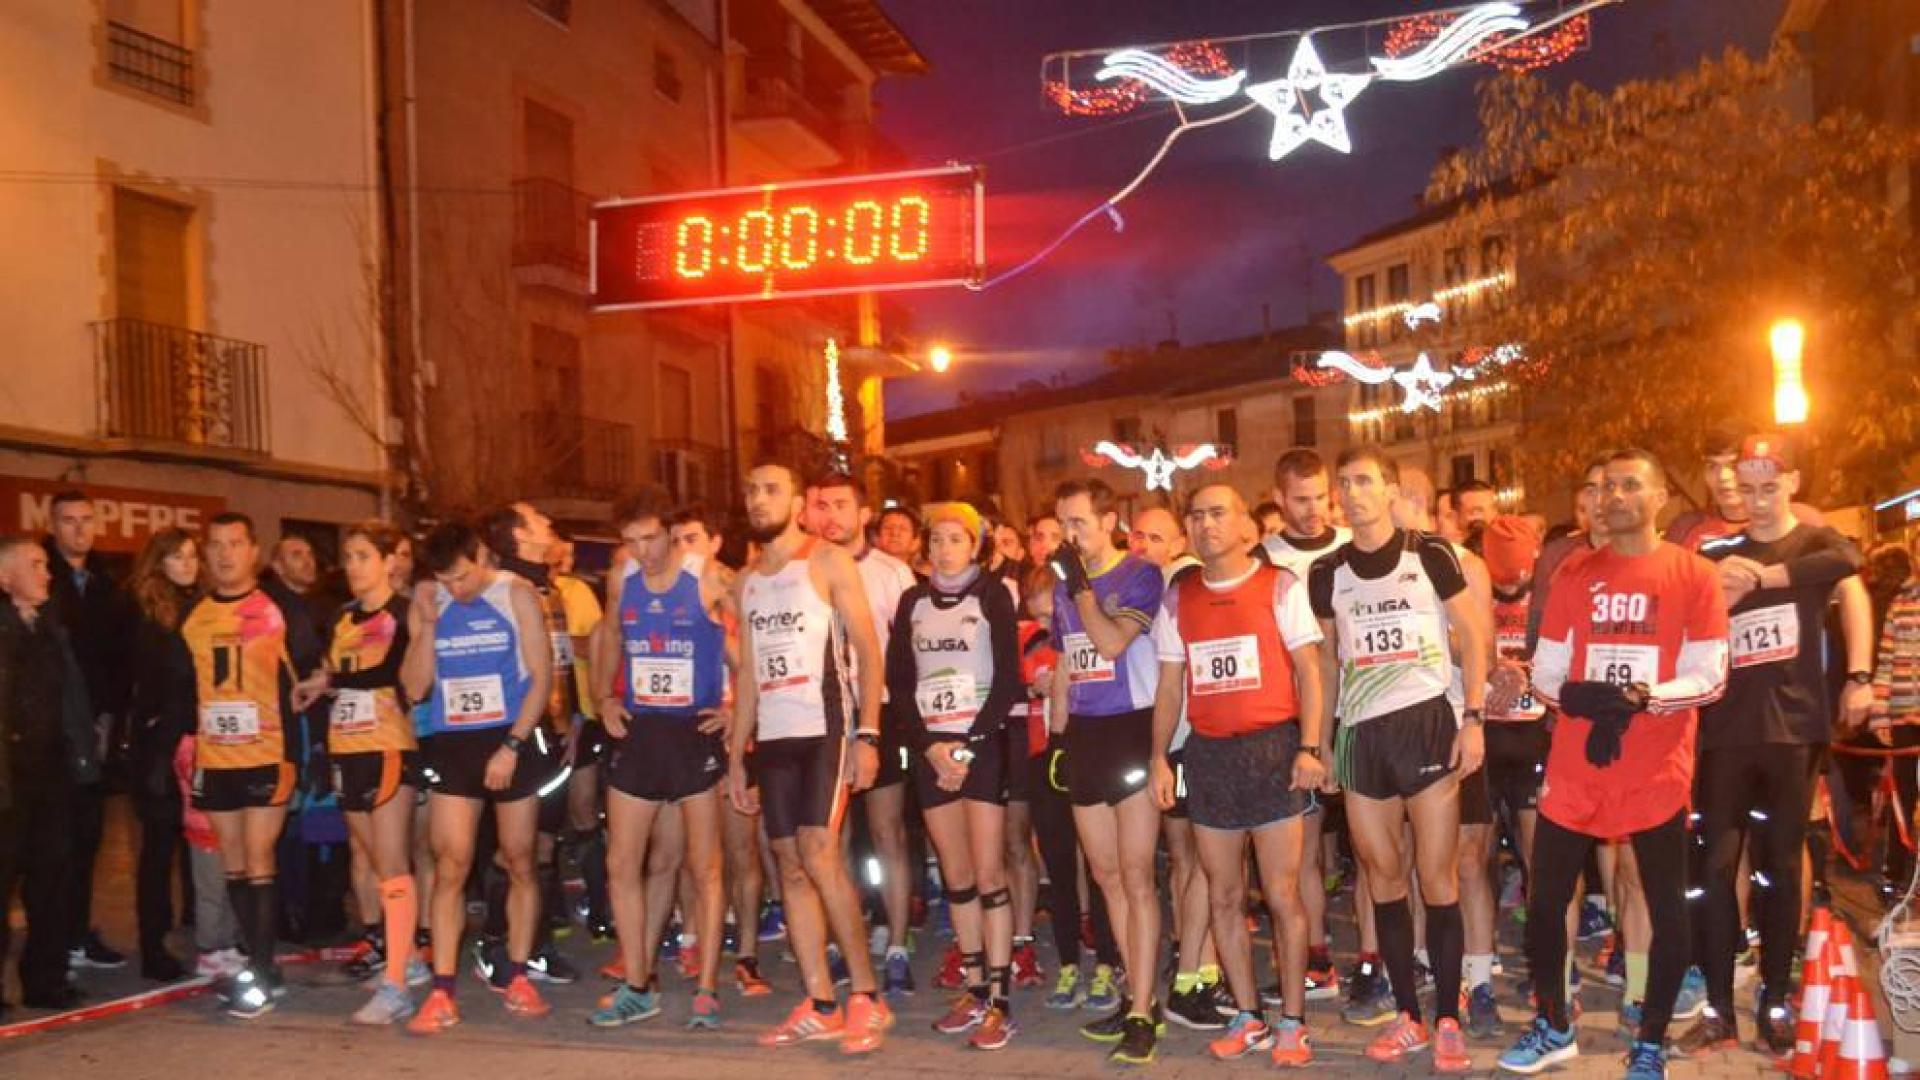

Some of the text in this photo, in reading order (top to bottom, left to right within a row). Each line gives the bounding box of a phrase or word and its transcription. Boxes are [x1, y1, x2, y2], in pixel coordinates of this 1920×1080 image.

[676, 196, 930, 278] 0:00:00
[20, 492, 201, 539] MPFRE
[1592, 593, 1646, 623] 360
[1365, 627, 1403, 653] 133
[1744, 623, 1782, 651] 121
[1071, 648, 1099, 670] 107
[1211, 655, 1237, 679] 80
[651, 673, 672, 694] 82
[1606, 663, 1632, 686] 69
[461, 692, 483, 712] 29
[933, 691, 957, 712] 42
[216, 716, 239, 734] 98
